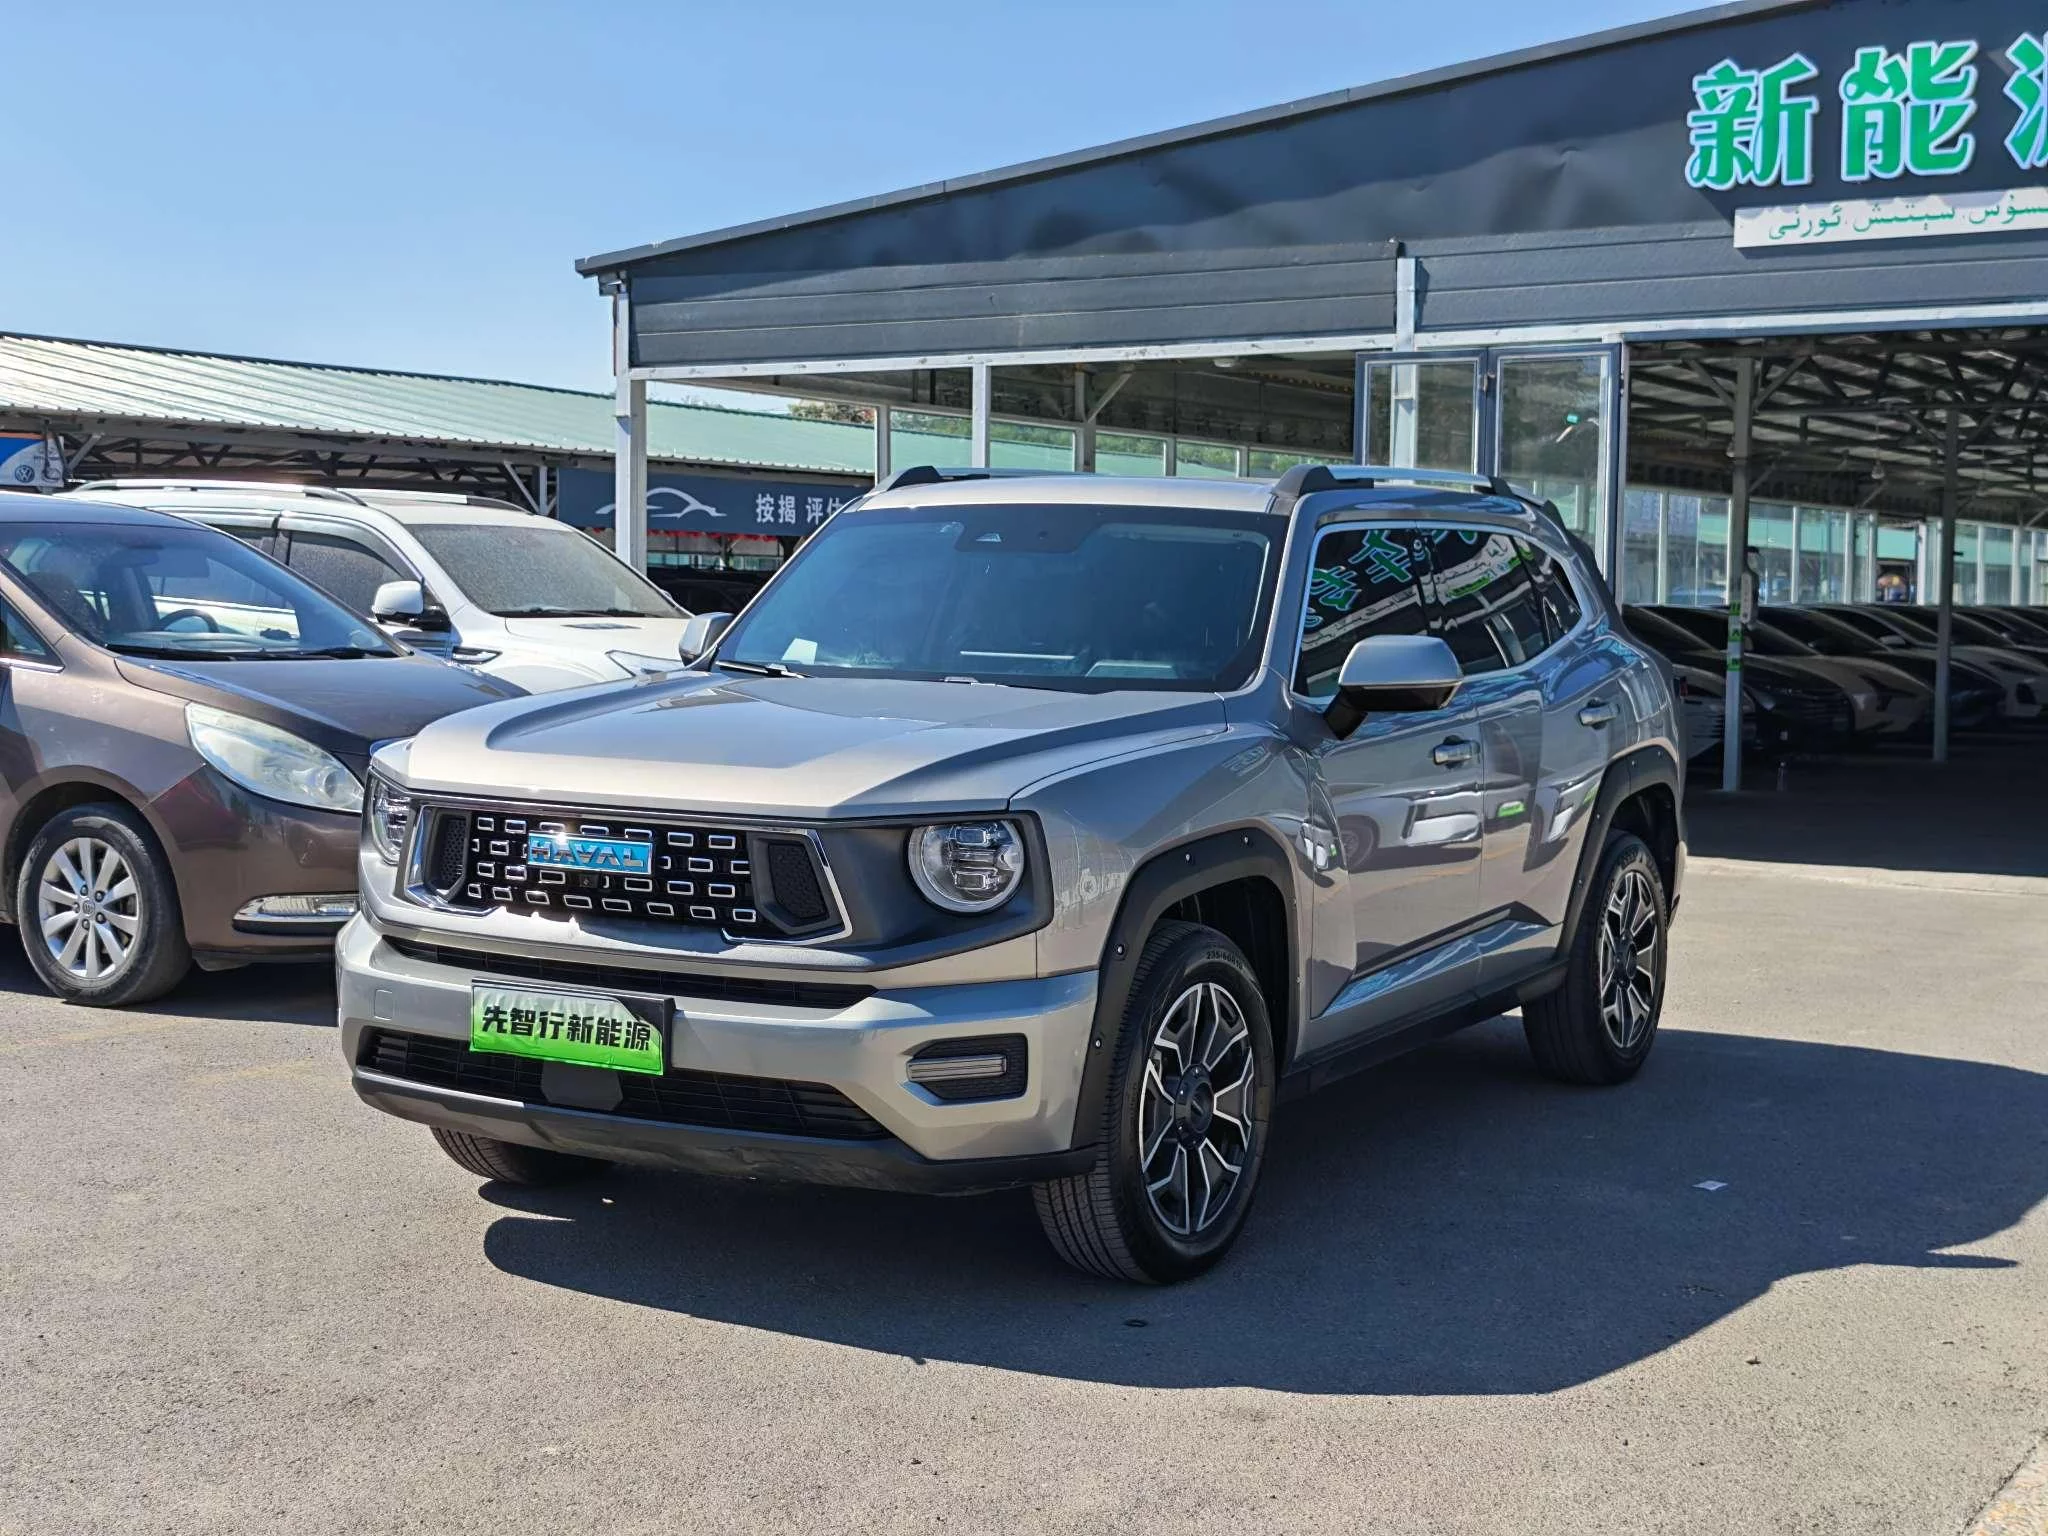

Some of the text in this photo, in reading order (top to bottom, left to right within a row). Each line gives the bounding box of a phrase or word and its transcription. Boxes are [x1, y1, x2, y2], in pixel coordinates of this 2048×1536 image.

[756, 493, 796, 524] 按揭
[531, 839, 645, 868] HAVAL
[481, 1004, 652, 1052] 先智行新能源
